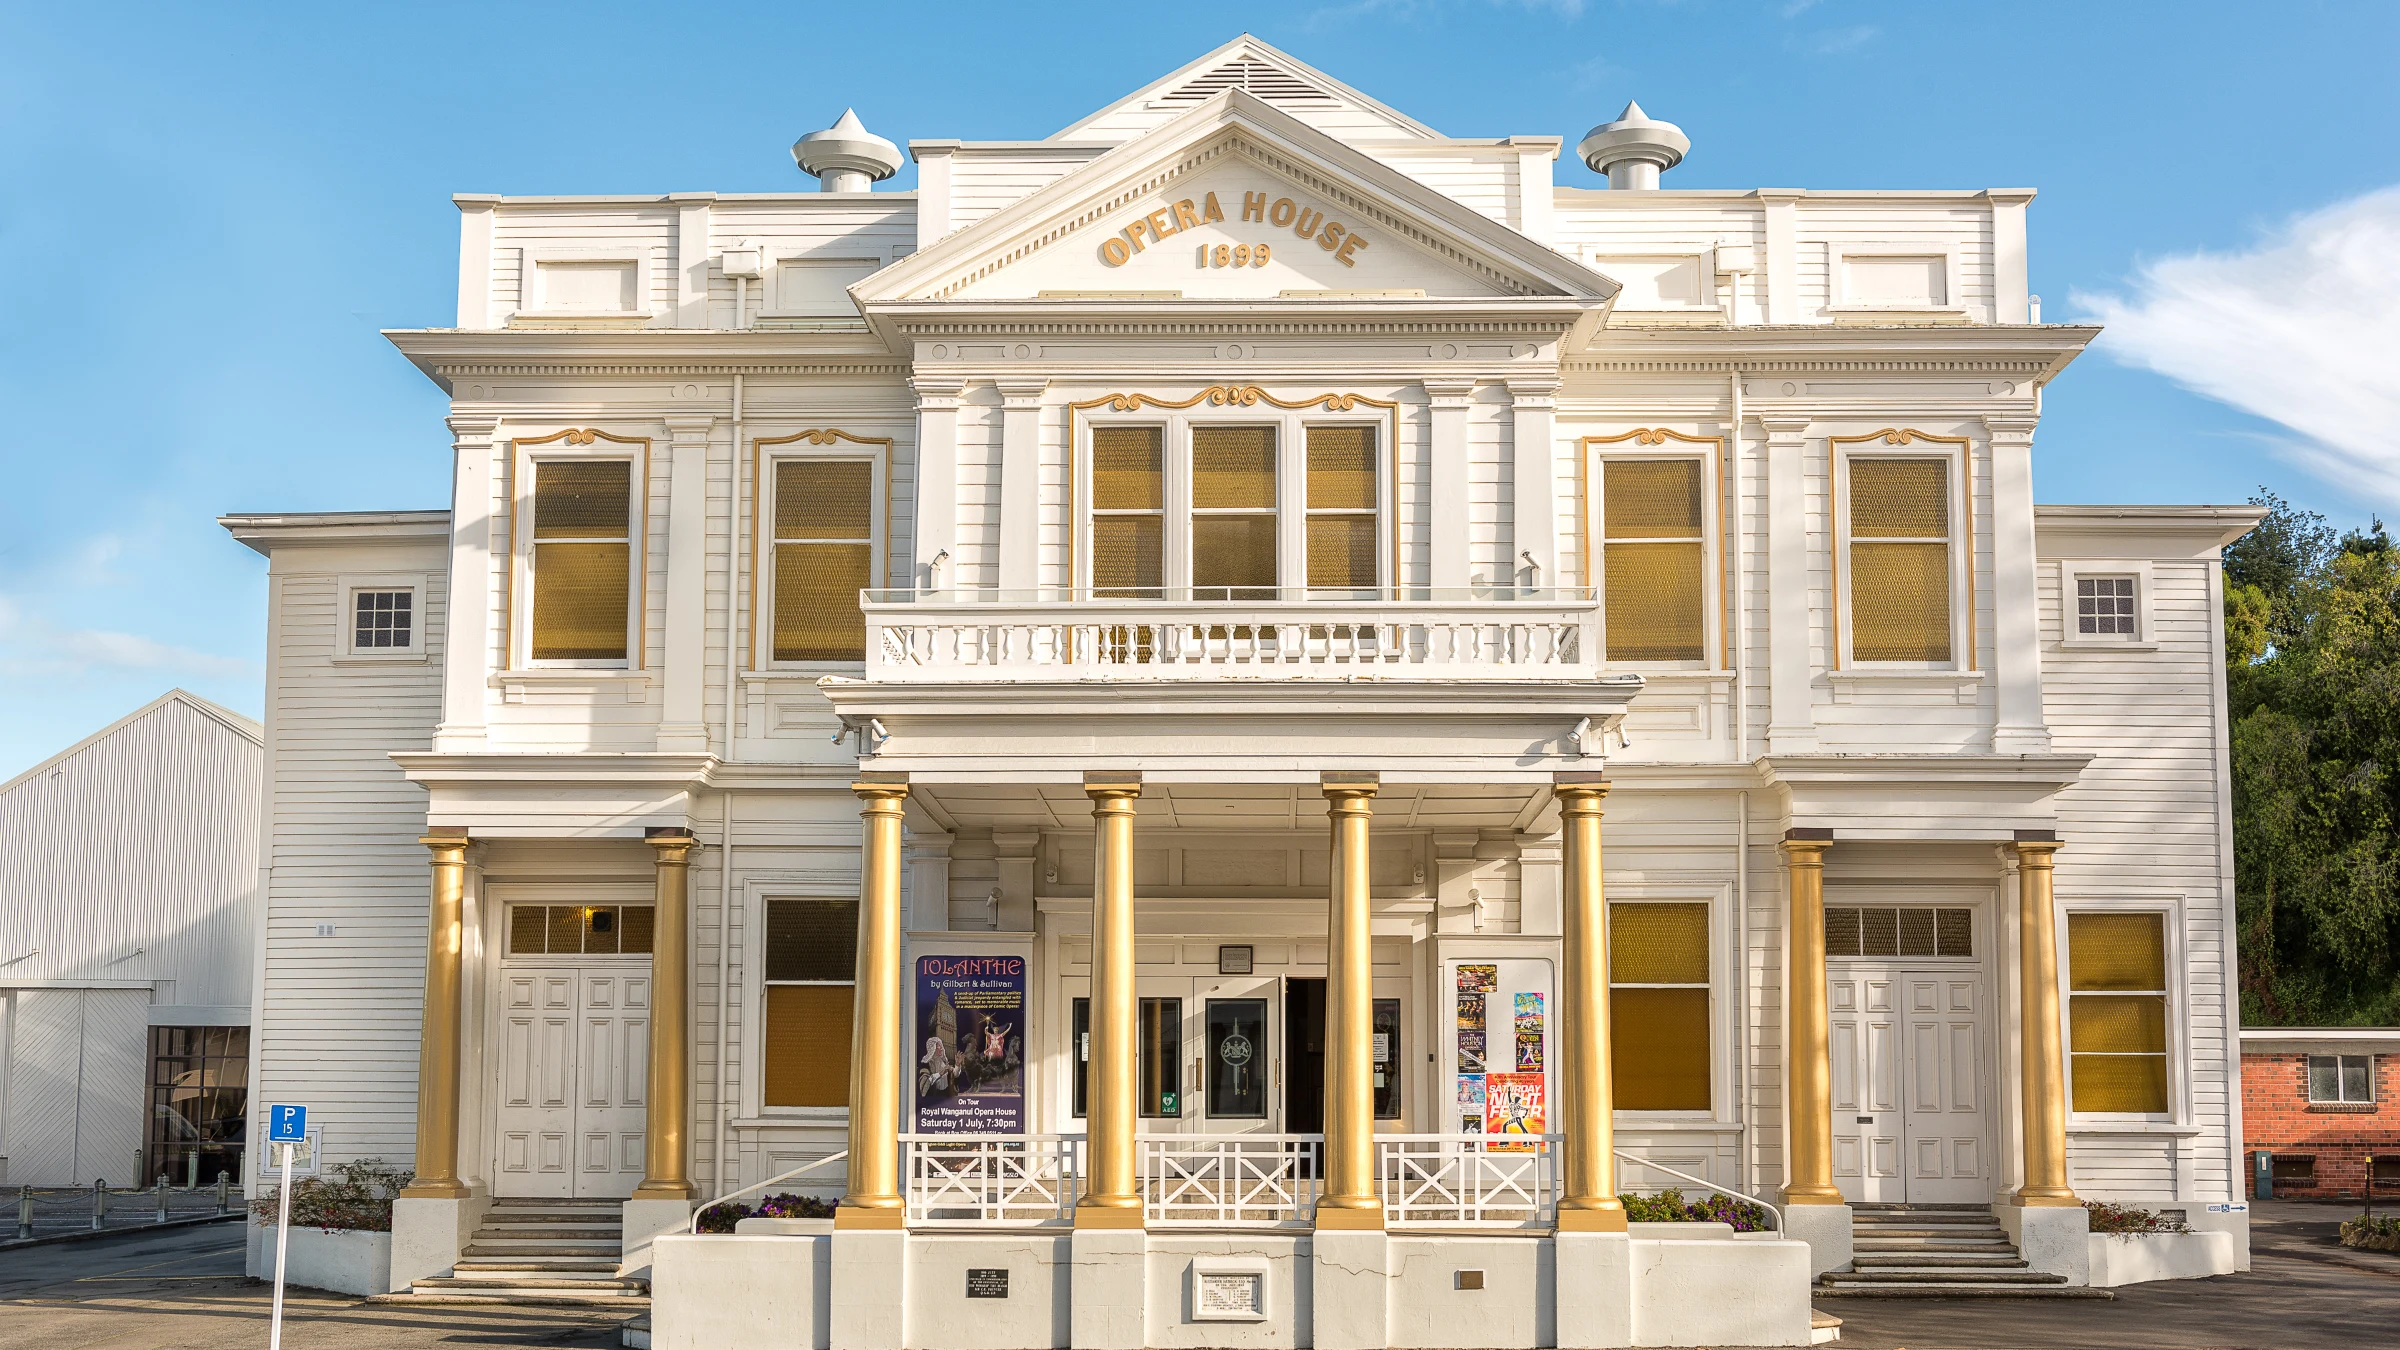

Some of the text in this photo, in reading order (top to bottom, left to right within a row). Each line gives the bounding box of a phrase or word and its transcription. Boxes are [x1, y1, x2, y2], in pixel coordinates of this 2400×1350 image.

[1102, 190, 1369, 268] OPERA HOUSE
[1200, 243, 1272, 268] 1899
[923, 959, 1022, 977] IOLANTHE
[931, 980, 1013, 989] by Gilbert & Sullivan
[284, 1107, 296, 1121] P
[921, 1107, 1017, 1117] Royal Wanganui Opera House
[283, 1123, 293, 1134] 15
[921, 1118, 1016, 1129] Saturday 1 July, 7:30pm
